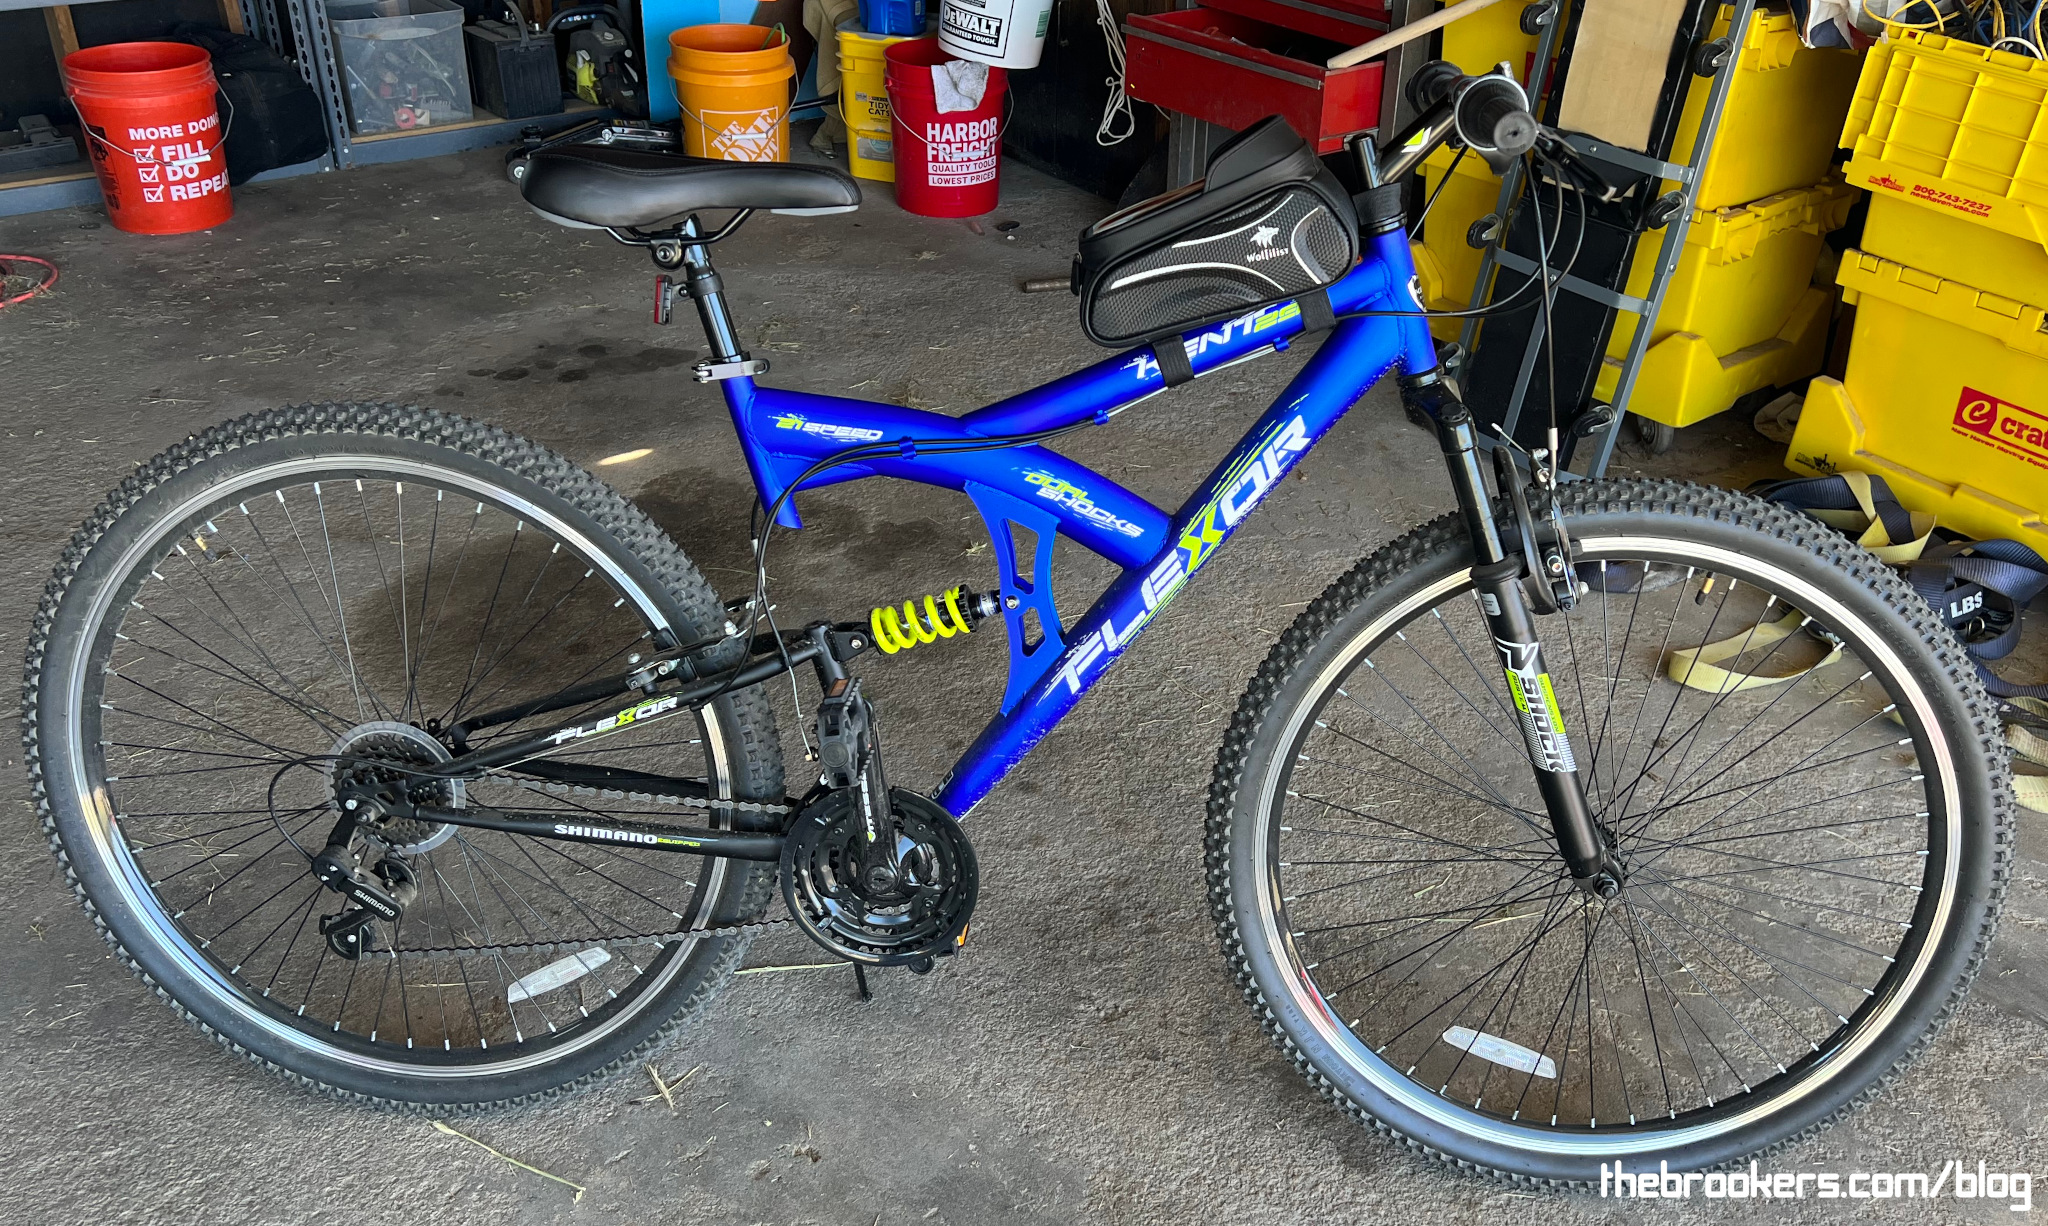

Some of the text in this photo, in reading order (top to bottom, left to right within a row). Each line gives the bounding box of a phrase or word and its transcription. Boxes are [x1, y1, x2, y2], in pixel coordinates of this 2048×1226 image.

[868, 101, 890, 110] TIDY
[868, 108, 890, 117] CATS
[128, 124, 184, 141] MORE
[926, 116, 998, 143] HARBOR
[161, 140, 210, 162] FILL
[926, 136, 997, 162] FREIGHT
[165, 163, 200, 182] DO
[931, 157, 995, 174] QUALITY TOOLS
[932, 171, 995, 185] LOWEST PRICES
[1910, 190, 1989, 218] newhaven-usa.com
[1913, 184, 1992, 212] 800-743-7237
[775, 416, 883, 441] 21 SPEED
[1951, 426, 1969, 438] New
[1970, 433, 1996, 448] Haven
[1997, 445, 2025, 461] Moving
[1023, 472, 1095, 505] DUAL
[1036, 487, 1145, 538] SHOCKS
[1047, 414, 1312, 695] FLEXOR
[1950, 591, 1983, 619] LBS
[550, 696, 678, 745] FLEXOR
[1520, 676, 1565, 772] SHOCK
[554, 824, 701, 848] SHIMANO EQUIPPED
[353, 889, 396, 917] SHIMANO
